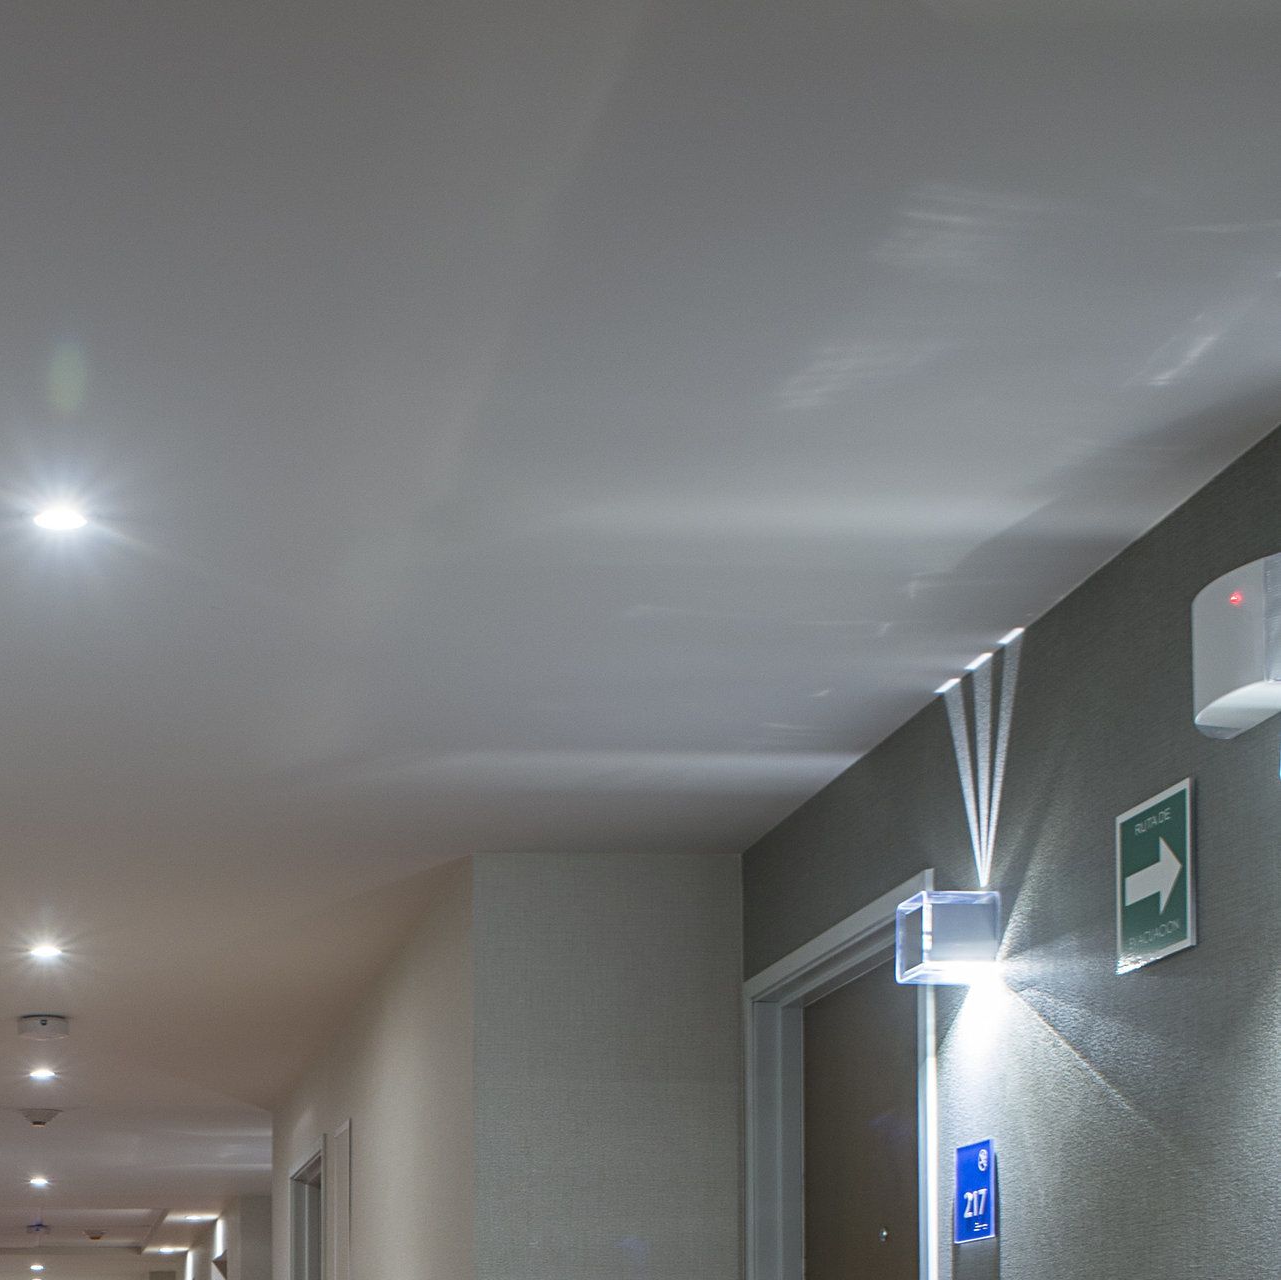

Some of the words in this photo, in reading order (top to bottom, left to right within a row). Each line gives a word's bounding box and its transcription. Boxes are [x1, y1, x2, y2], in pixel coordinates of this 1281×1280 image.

[1134, 816, 1158, 836] RUTA
[1158, 807, 1172, 824] DE
[963, 1188, 988, 1219] 217
